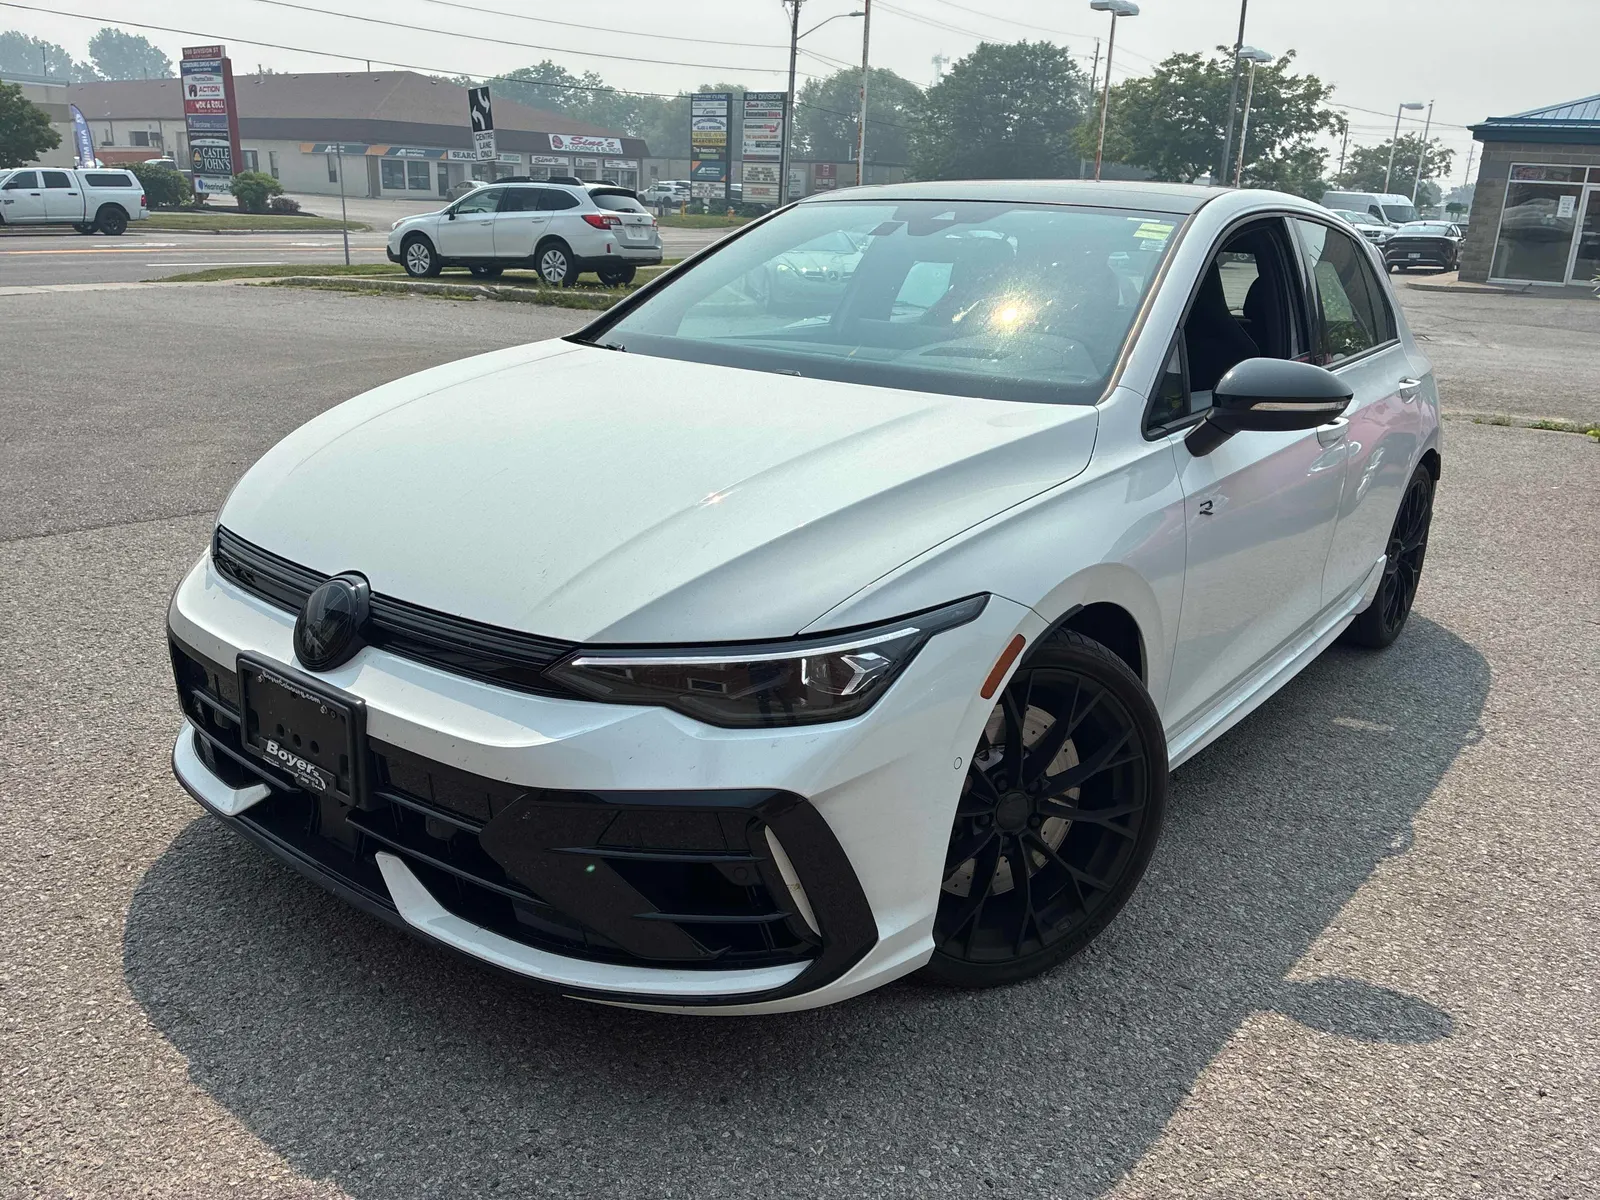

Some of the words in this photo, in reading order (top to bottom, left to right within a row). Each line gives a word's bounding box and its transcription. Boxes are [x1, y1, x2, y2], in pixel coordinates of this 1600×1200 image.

[193, 47, 213, 55] DIVISION
[198, 85, 221, 93] ACTION
[211, 100, 224, 109] ROLL
[475, 132, 493, 141] CENTRE
[479, 141, 492, 149] LANE
[569, 136, 615, 147] Sine's
[202, 147, 230, 159] CASTLE
[480, 150, 492, 158] ONLY
[204, 158, 231, 171] JOHN'S
[266, 740, 315, 773] Boyer
